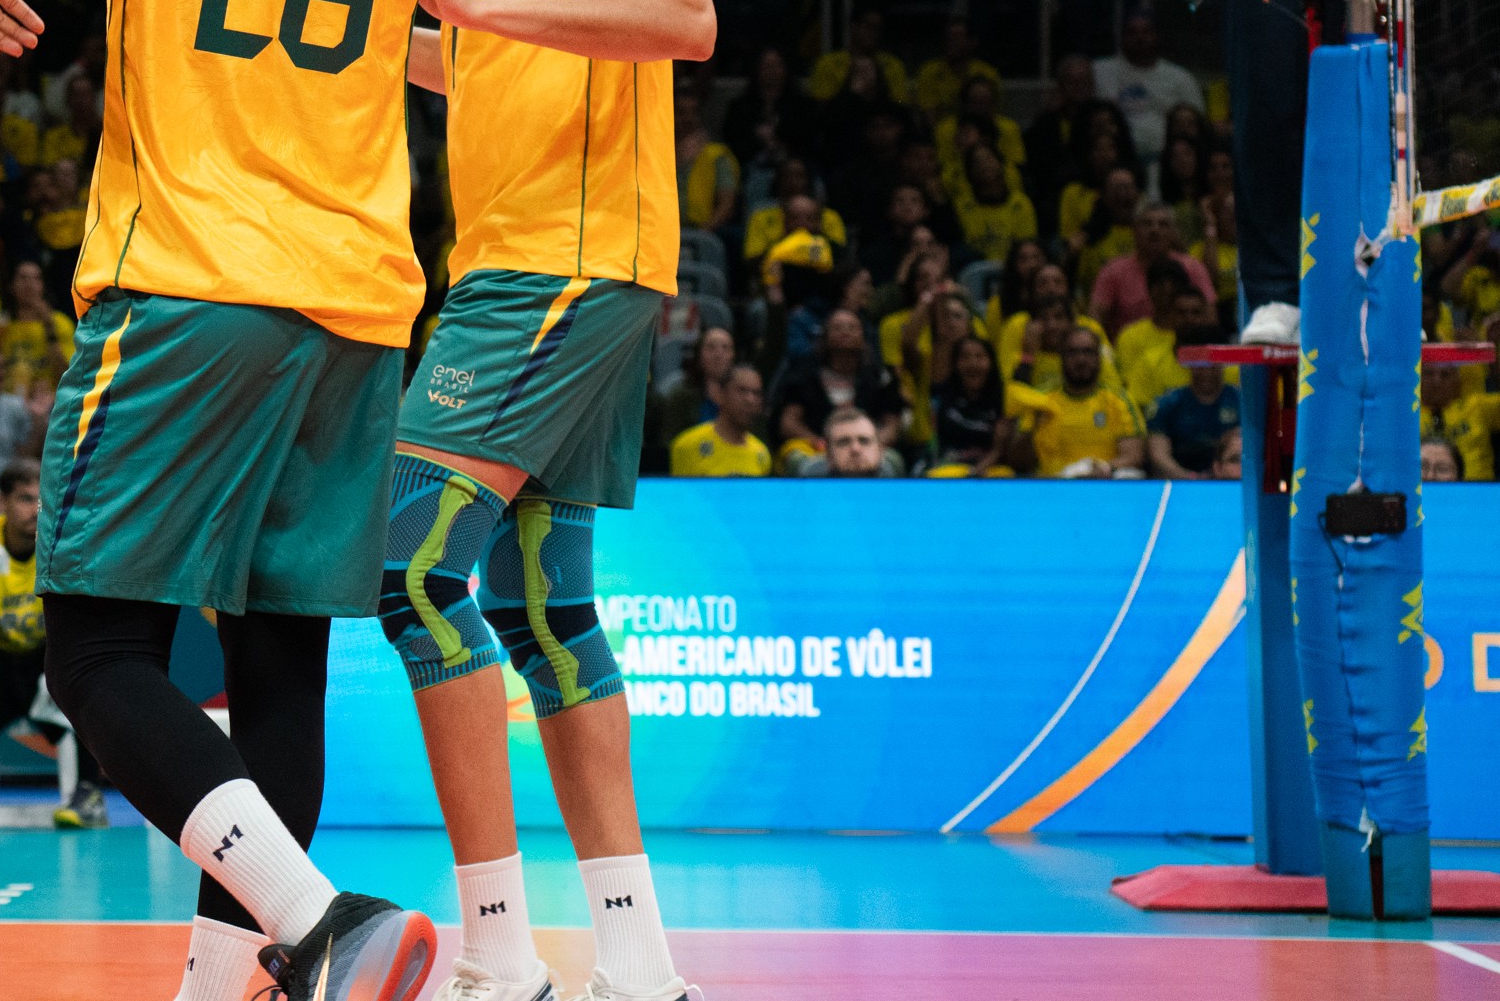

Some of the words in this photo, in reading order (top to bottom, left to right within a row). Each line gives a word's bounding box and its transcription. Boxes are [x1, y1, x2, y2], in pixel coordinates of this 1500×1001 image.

[429, 377, 469, 394] BRASIL
[433, 364, 476, 387] enel
[427, 389, 467, 409] VOLT
[594, 594, 738, 632] MPEONATO
[614, 634, 796, 677] -AMERICANO
[801, 635, 843, 678] DE
[845, 627, 933, 679] VÔLEI
[624, 681, 687, 717] ANCO
[689, 681, 726, 717] DO
[729, 681, 821, 718] BRASIL
[212, 824, 244, 863] N1
[479, 901, 506, 917] N1
[605, 895, 633, 909] N1
